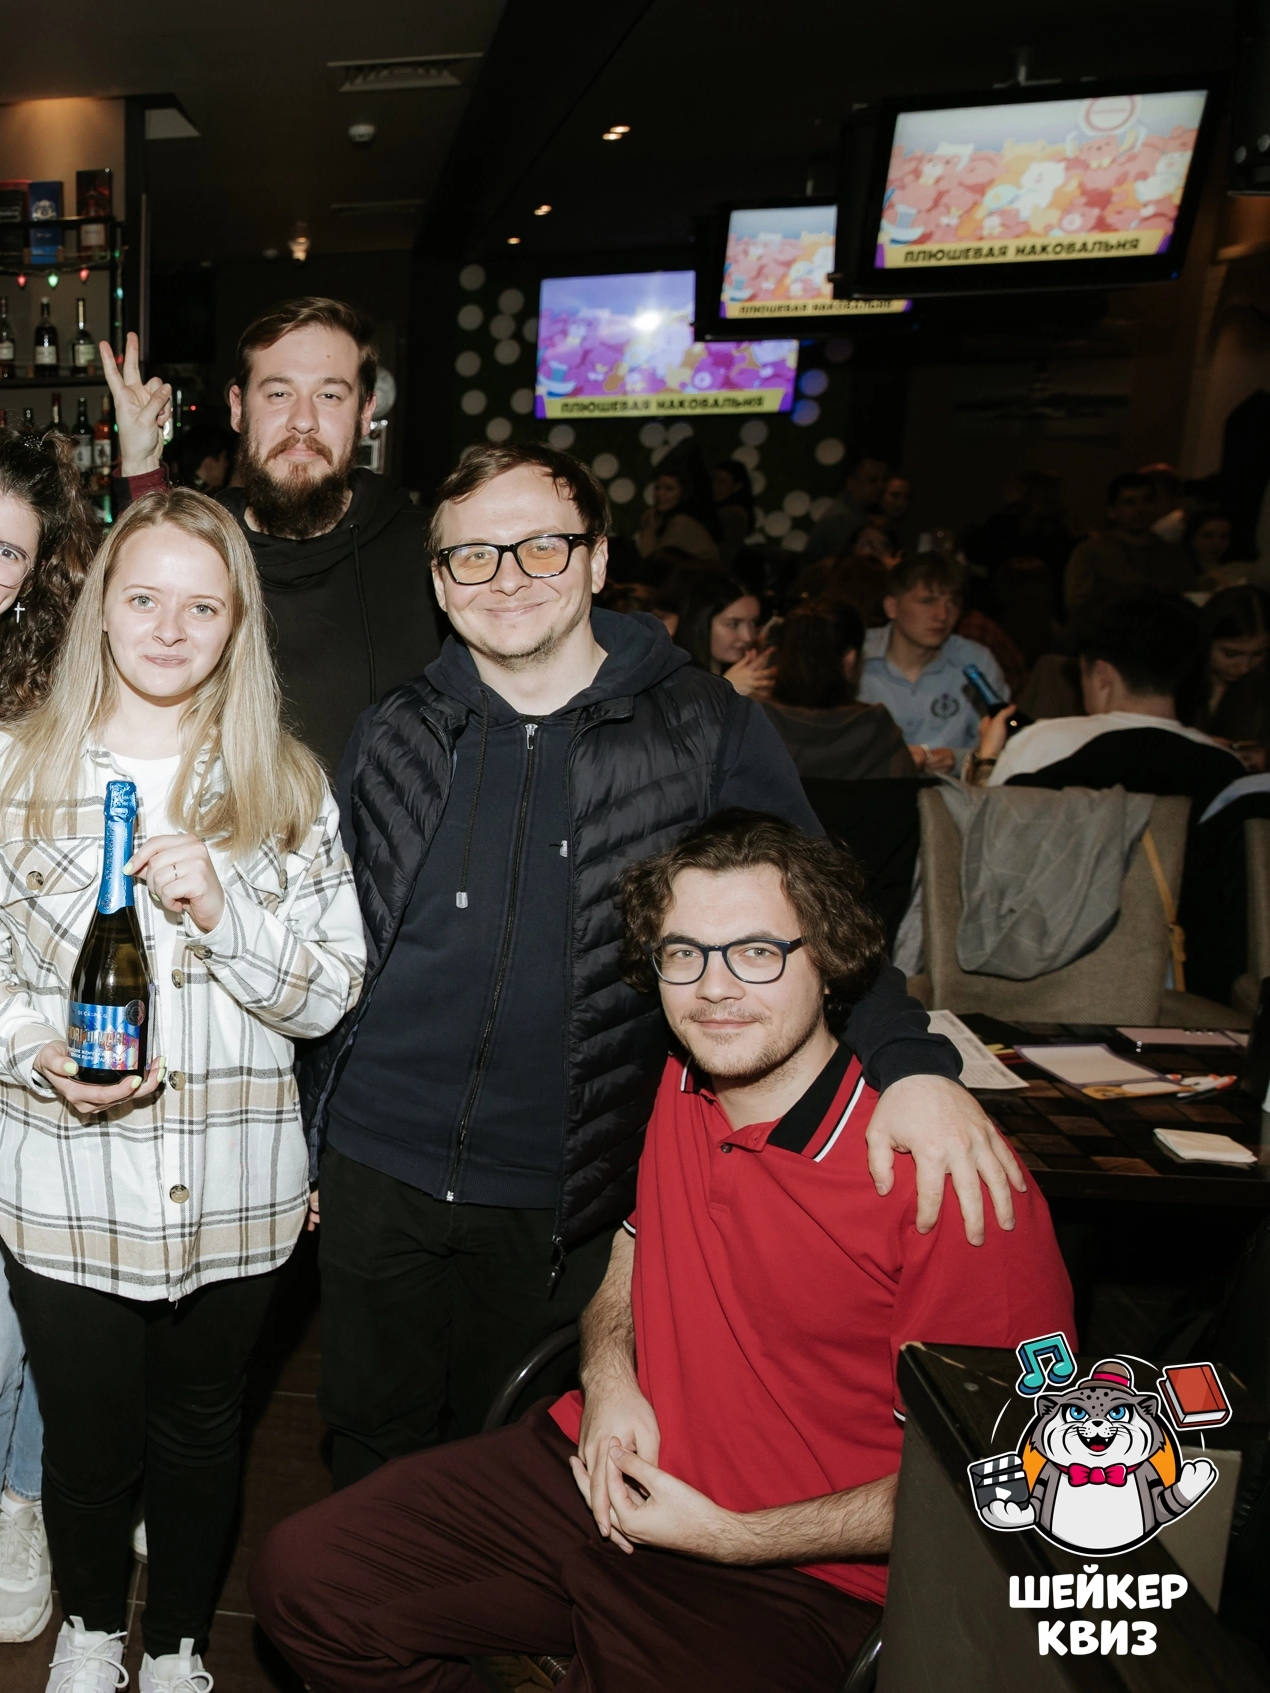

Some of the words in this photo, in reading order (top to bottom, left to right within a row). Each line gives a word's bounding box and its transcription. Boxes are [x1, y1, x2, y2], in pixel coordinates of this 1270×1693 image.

[904, 245, 1009, 264] ПЛЮШЕВАЯ
[1014, 238, 1141, 259] НАКОВАЛЬНЯ
[560, 399, 650, 414] ПЛЮШЕВАЯ
[655, 395, 766, 411] НАКОВАЛЬНЯ
